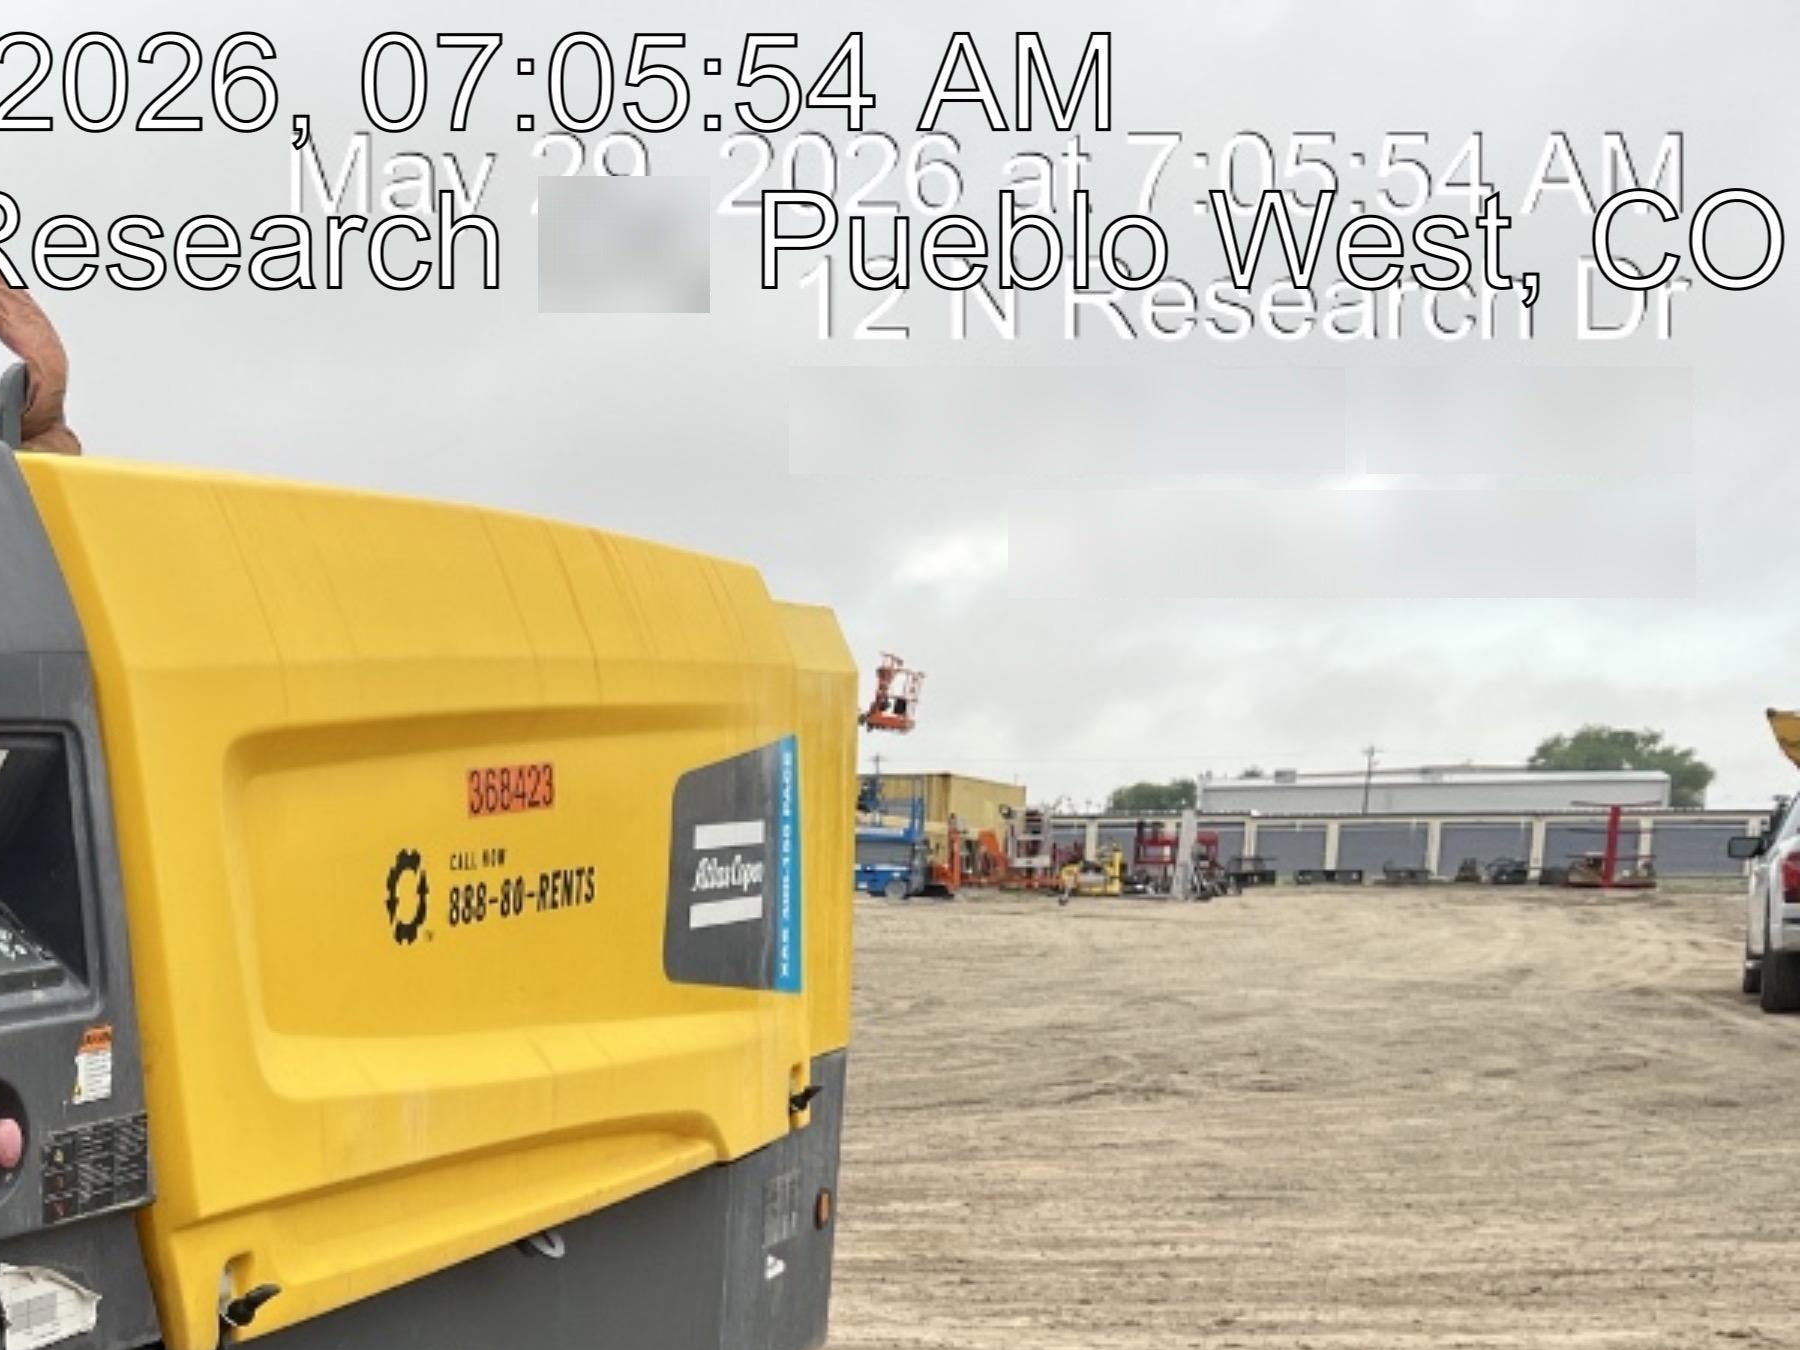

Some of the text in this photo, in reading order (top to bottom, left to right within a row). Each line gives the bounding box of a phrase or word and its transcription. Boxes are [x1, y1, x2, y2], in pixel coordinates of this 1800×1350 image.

[469, 763, 554, 815] 368423
[450, 848, 506, 871] CALL NOW
[449, 866, 596, 928] 888-80-RENTS
